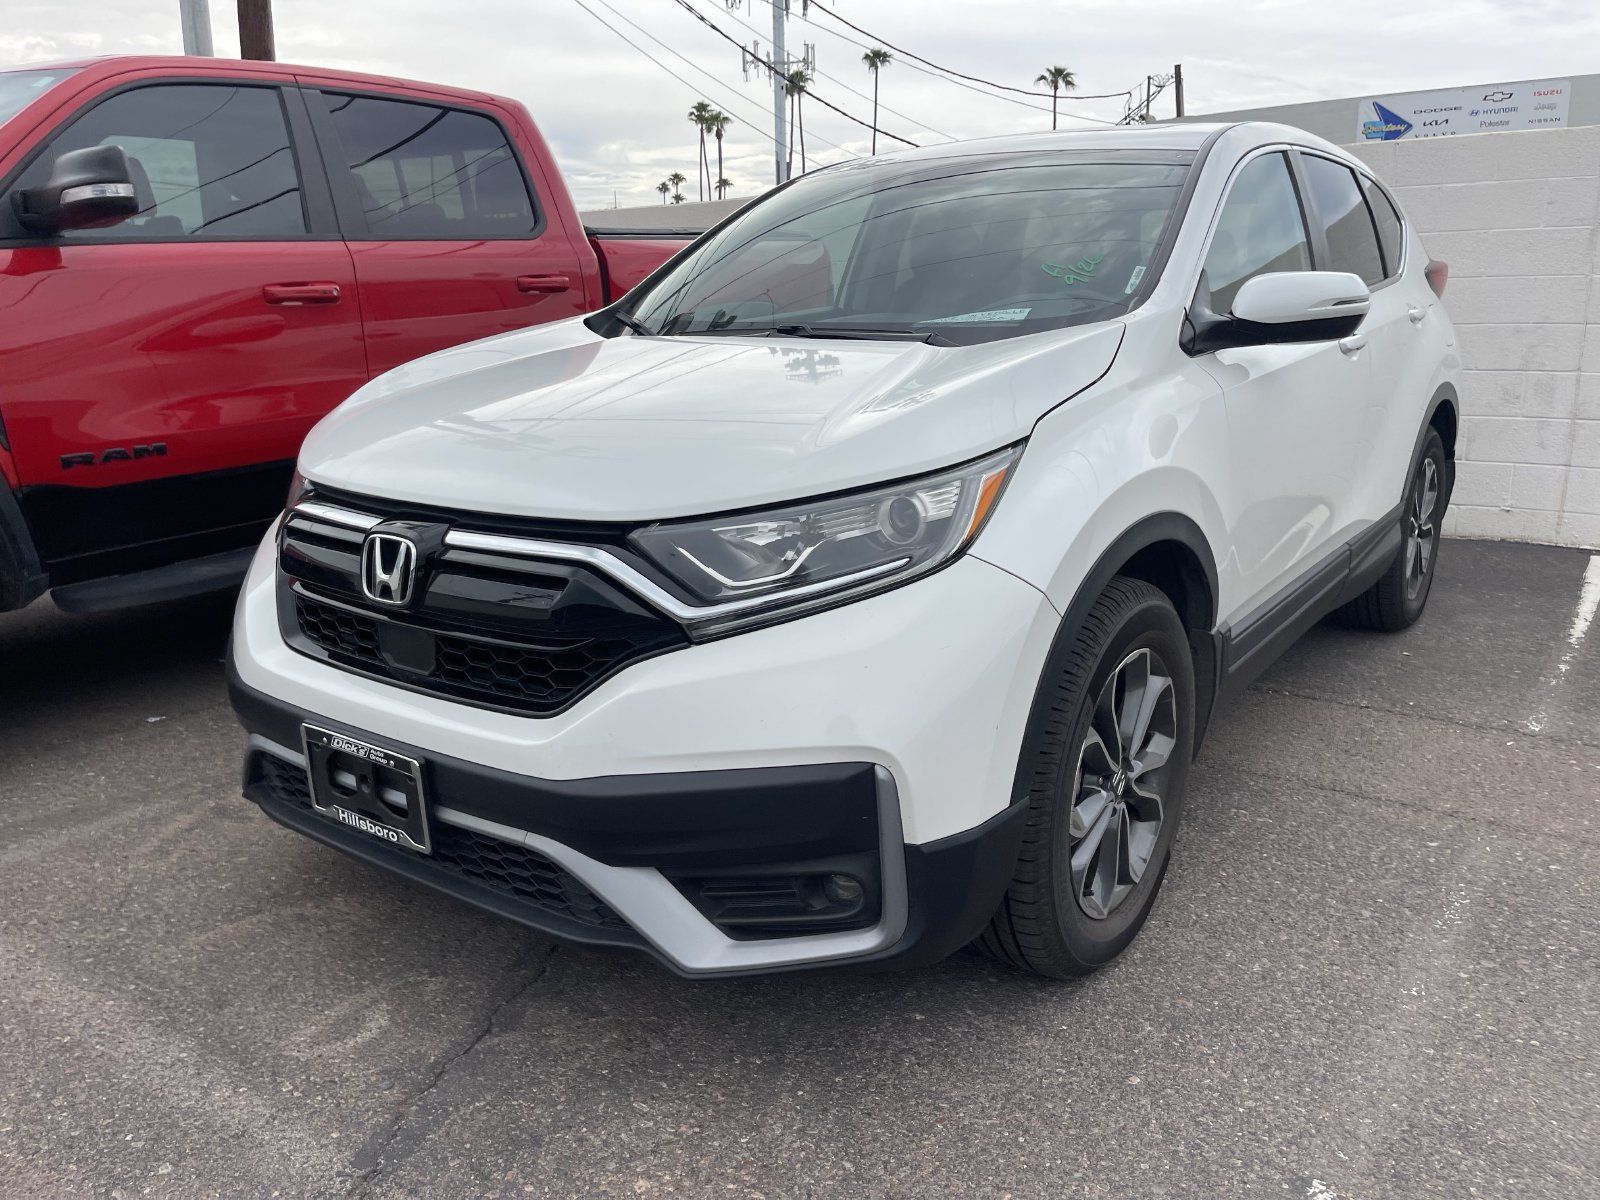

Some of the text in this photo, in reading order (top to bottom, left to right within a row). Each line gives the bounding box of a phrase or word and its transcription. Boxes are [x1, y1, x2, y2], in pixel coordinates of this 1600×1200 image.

[1533, 89, 1562, 97] ISUZU
[1414, 106, 1462, 114] DODGE
[1528, 117, 1561, 125] NISSAN
[60, 443, 168, 469] RAM
[333, 739, 365, 756] Dick's
[370, 749, 384, 757] Auto
[369, 754, 388, 764] Group
[339, 808, 398, 842] Hillsboro
